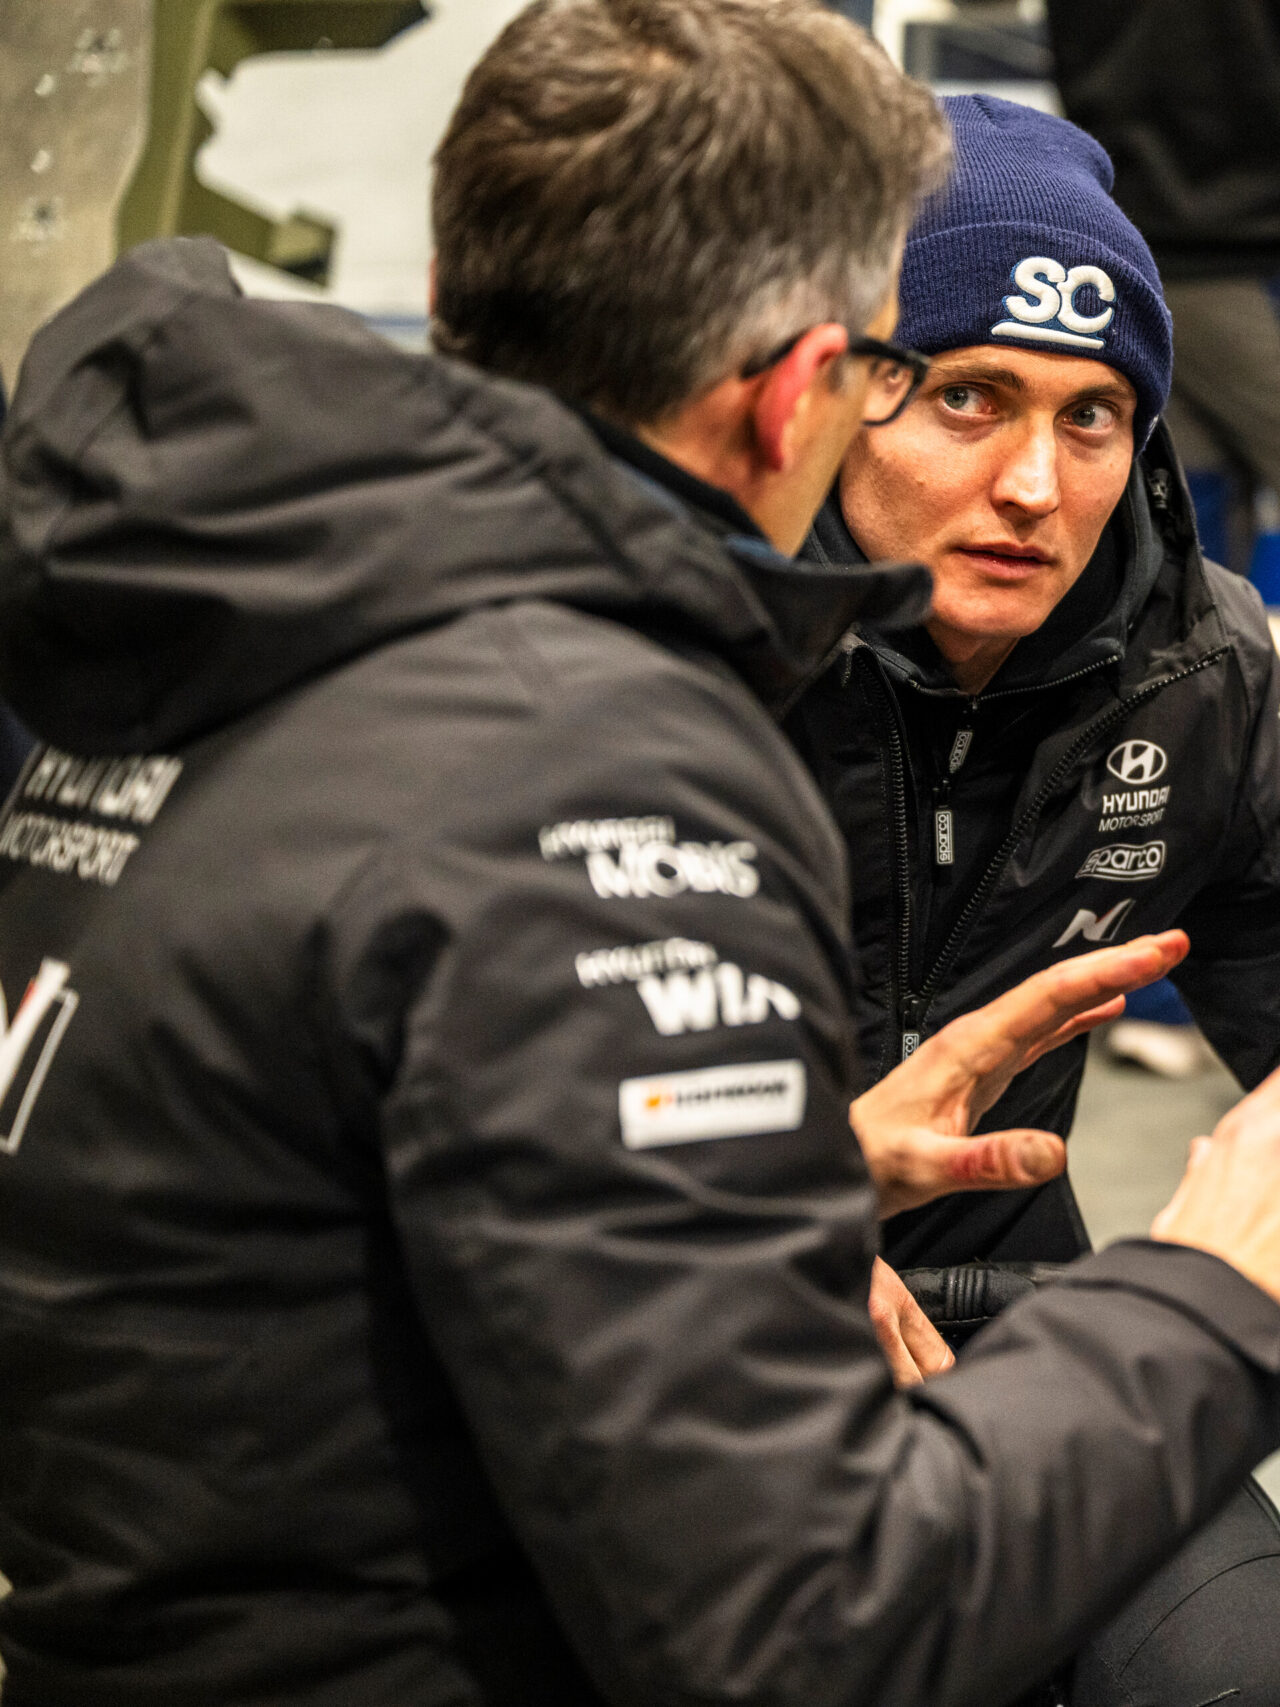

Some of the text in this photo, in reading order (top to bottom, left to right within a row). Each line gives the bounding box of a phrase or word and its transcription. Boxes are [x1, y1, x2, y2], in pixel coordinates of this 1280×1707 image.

[1001, 255, 1115, 334] SC
[1102, 786, 1171, 814] HYUNDAI
[1098, 808, 1165, 832] MOTORSPORT
[938, 814, 950, 862] sparco
[1080, 846, 1161, 875] sparco
